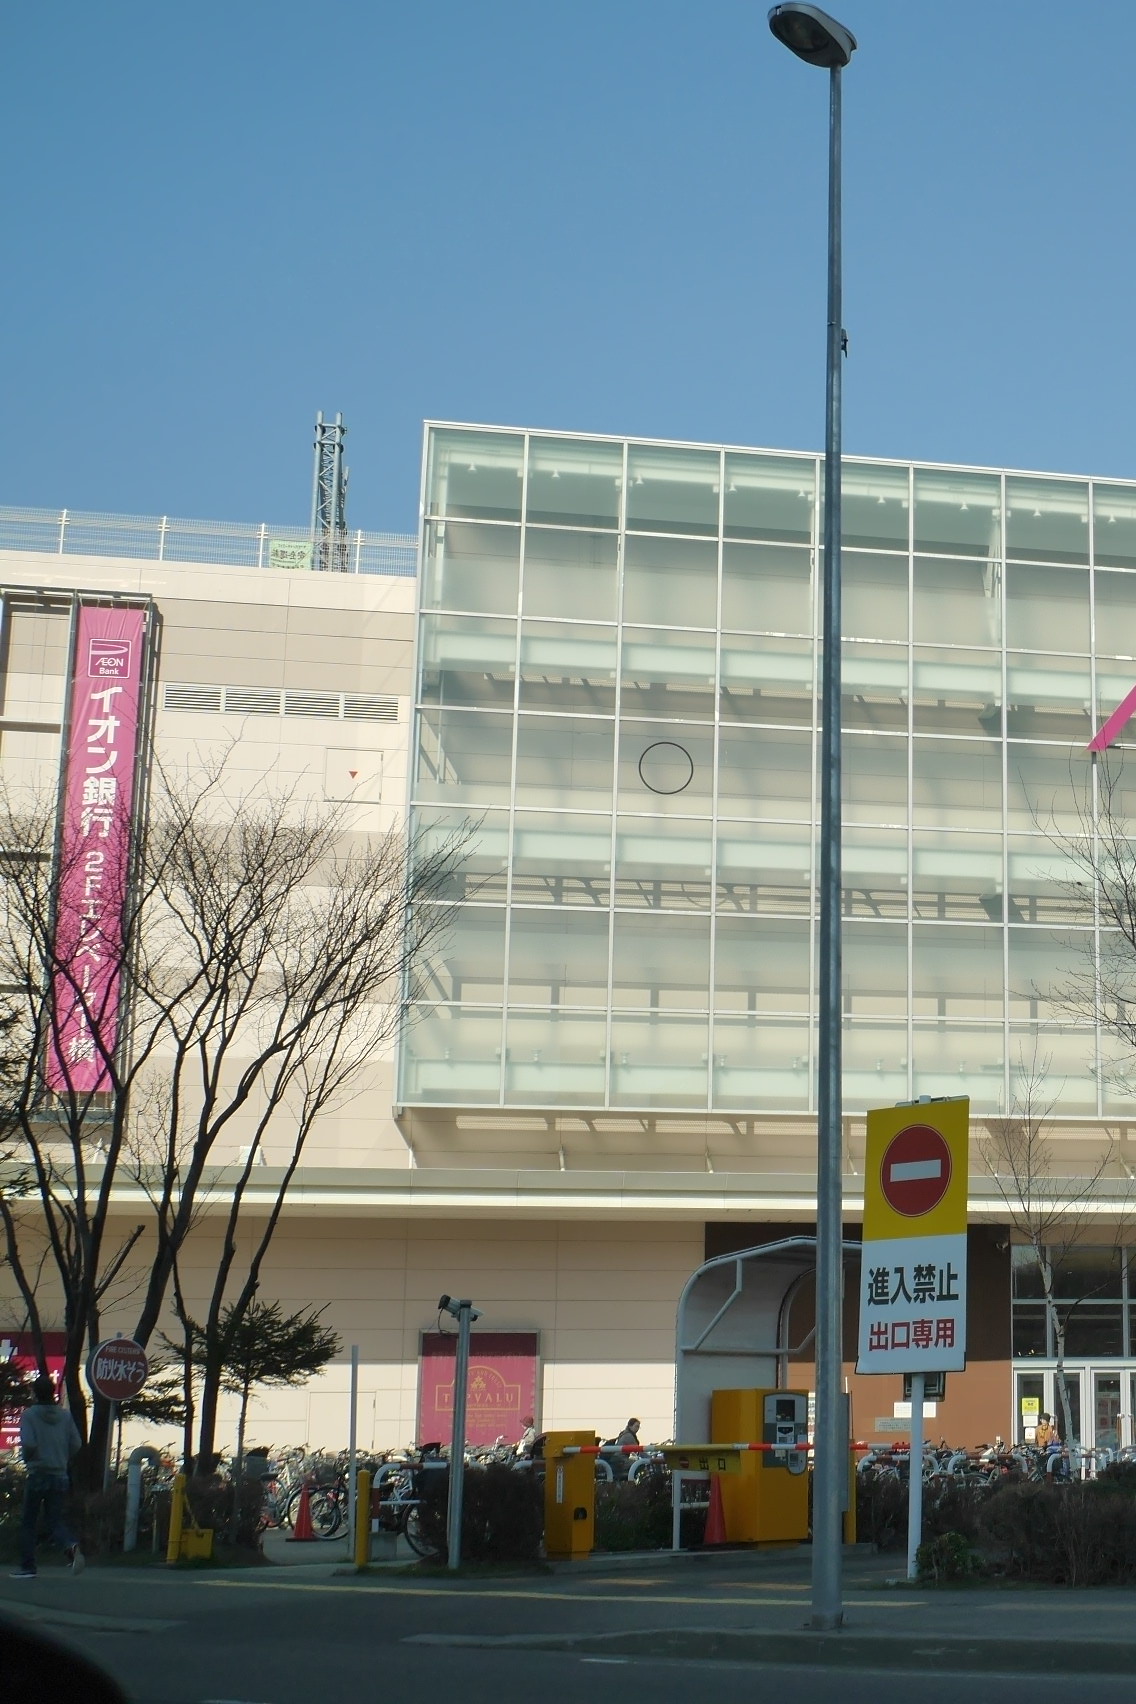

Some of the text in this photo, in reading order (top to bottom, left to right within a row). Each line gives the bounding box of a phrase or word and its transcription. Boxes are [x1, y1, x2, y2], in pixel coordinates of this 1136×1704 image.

[99, 667, 119, 675] Bank
[81, 685, 122, 838] イオン銀行
[867, 1262, 959, 1306] 進入禁止
[868, 1318, 955, 1351] 出口専用
[97, 1358, 145, 1383] 防火水そう
[443, 1393, 513, 1403] TVALU
[699, 1456, 727, 1471] 出口
